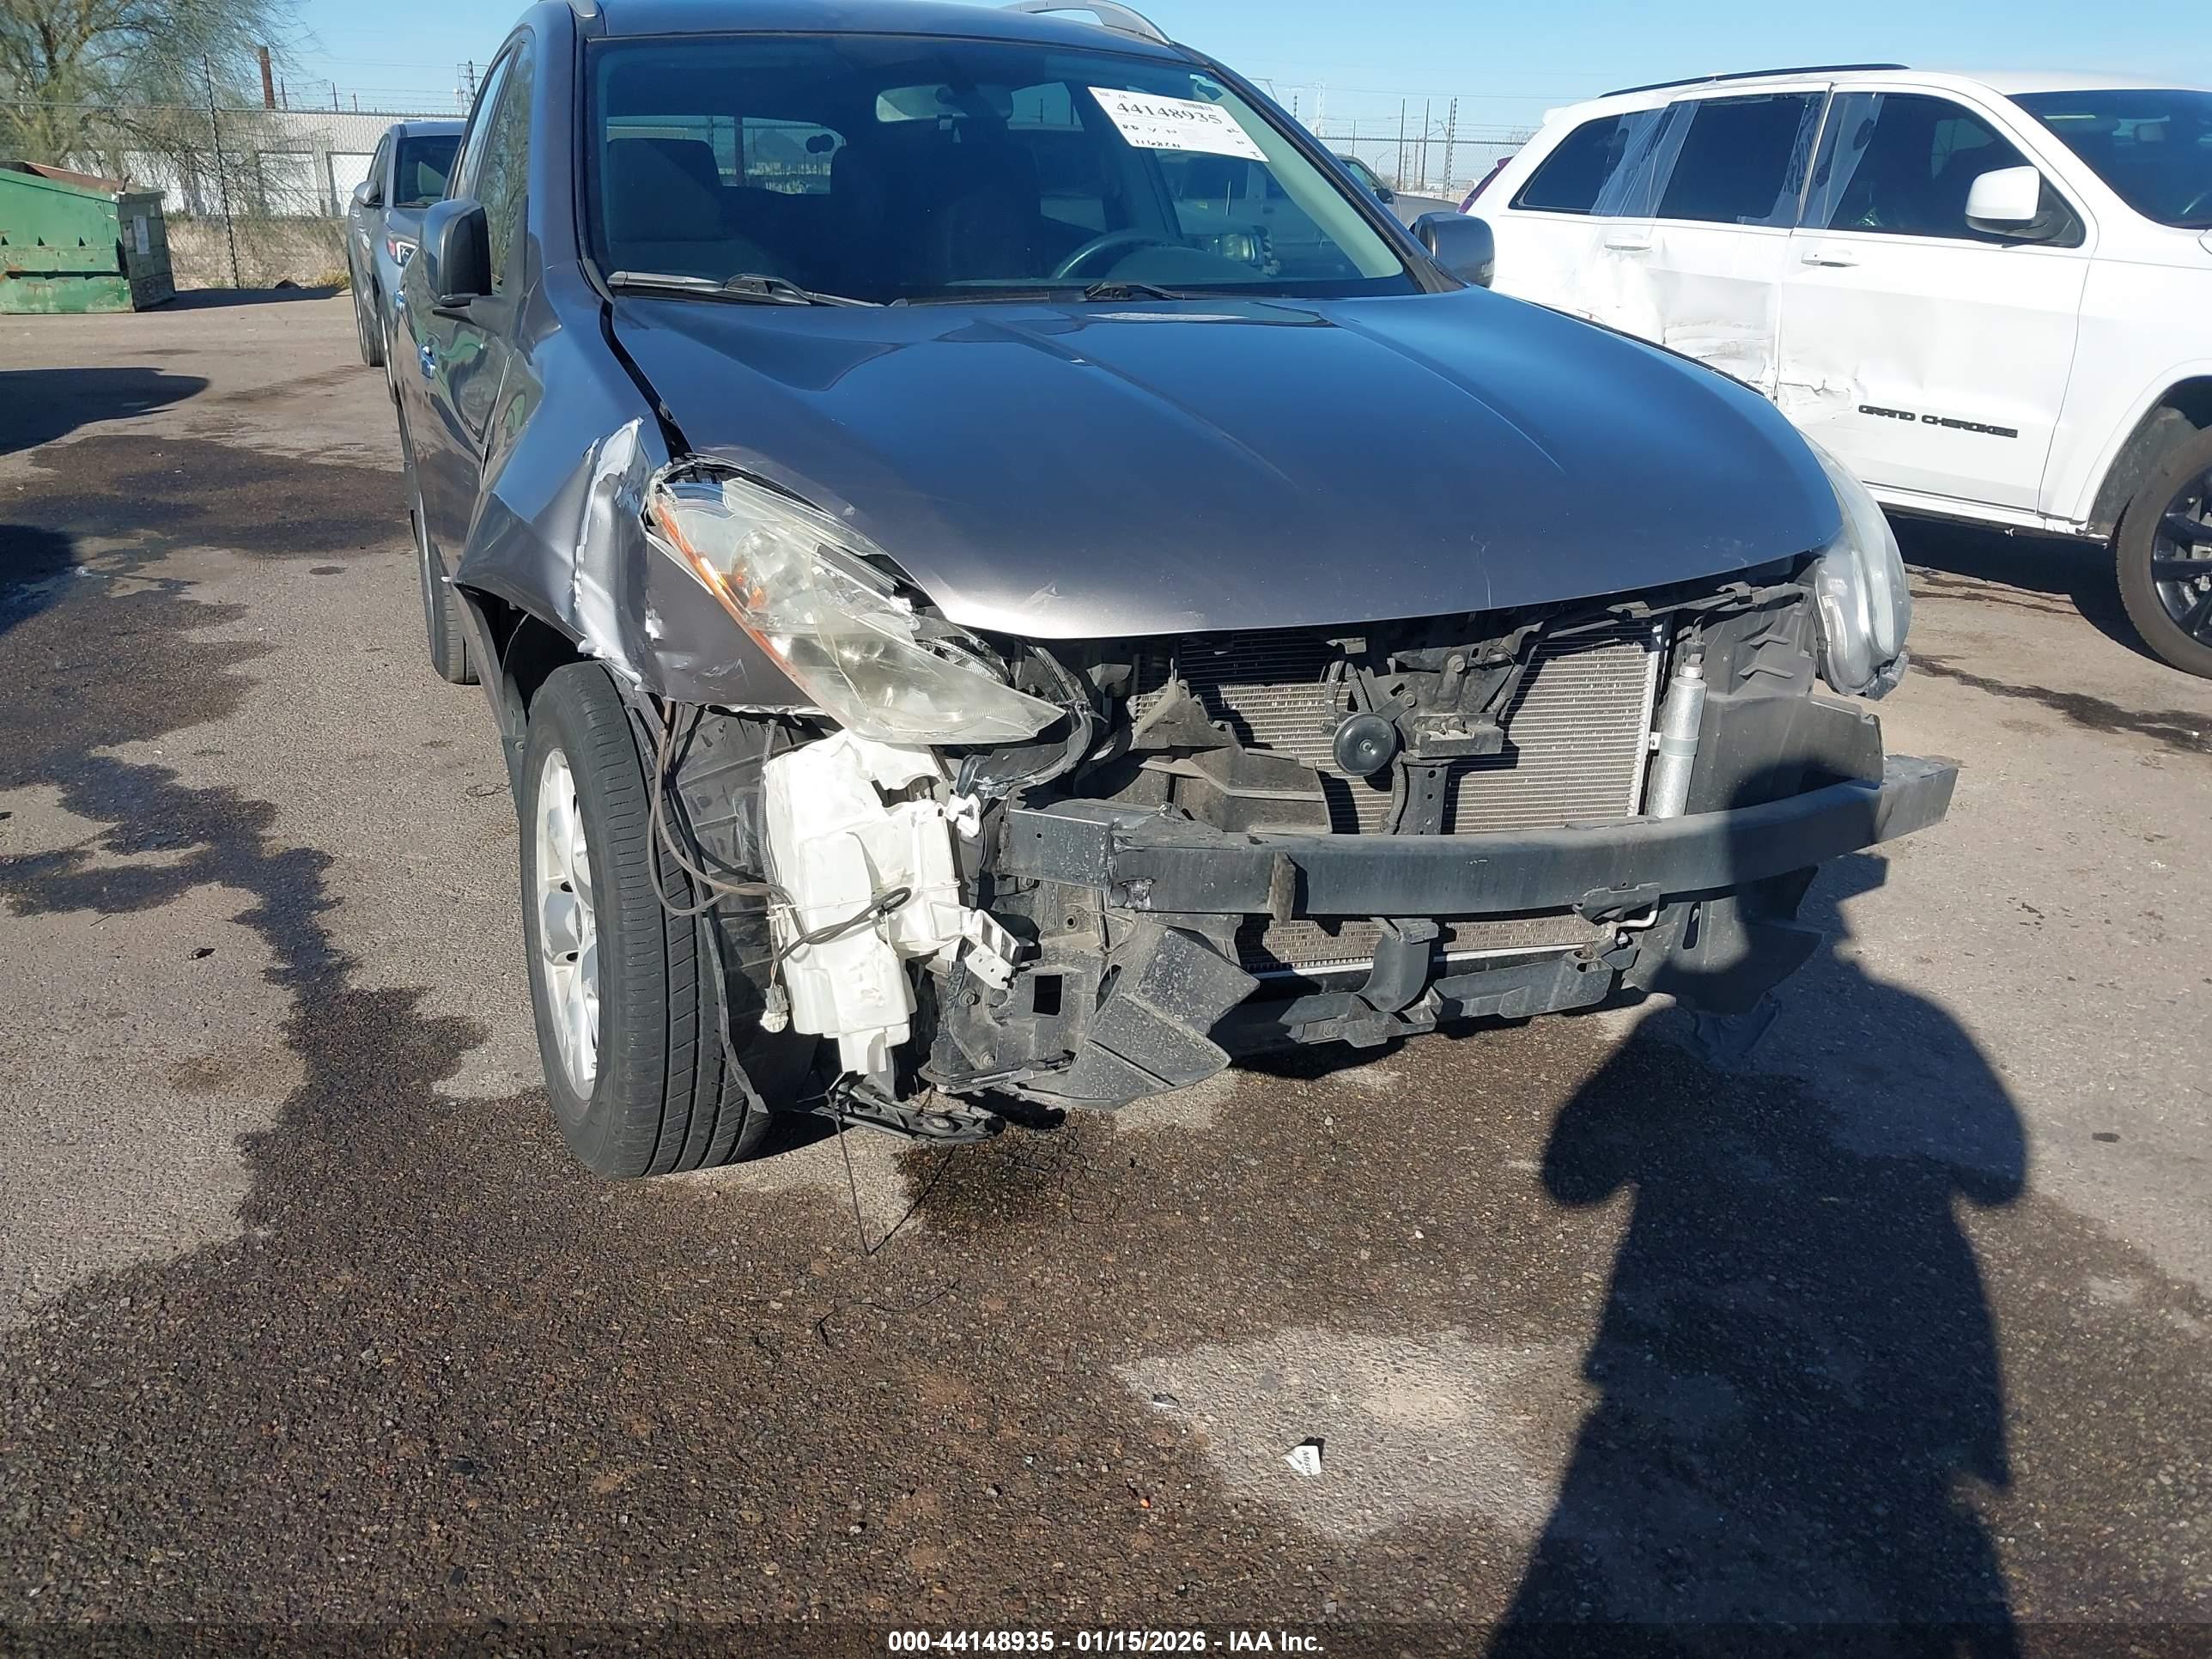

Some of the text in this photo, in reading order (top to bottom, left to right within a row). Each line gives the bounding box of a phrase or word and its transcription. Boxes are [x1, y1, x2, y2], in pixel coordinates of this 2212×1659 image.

[1116, 102, 1223, 125] 44148935
[1858, 404, 2018, 438] GRAND CHEROKEE
